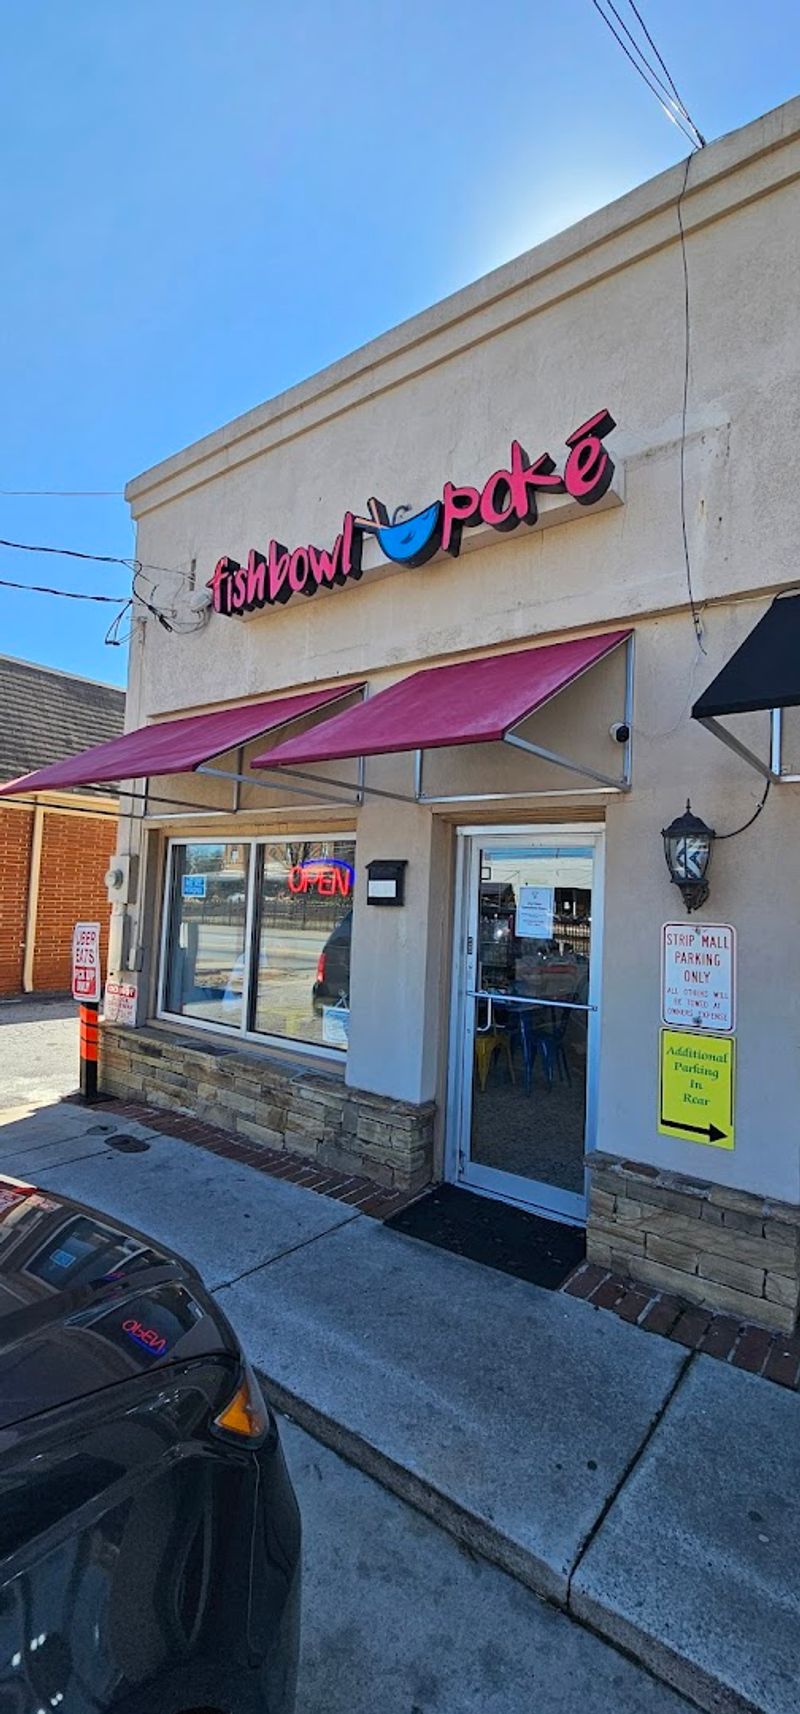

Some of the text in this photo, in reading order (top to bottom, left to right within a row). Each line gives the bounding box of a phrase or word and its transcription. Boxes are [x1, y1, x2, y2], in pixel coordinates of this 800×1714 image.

[207, 510, 360, 614] fishbowl
[287, 864, 352, 897] OPEN
[76, 930, 96, 946] UBER
[666, 933, 729, 949] STRIP MALL
[76, 947, 96, 964] EATS
[674, 950, 721, 967] PARKING
[683, 969, 711, 984] ONLY
[666, 987, 678, 995] ALL
[713, 991, 729, 1000] WILL
[687, 999, 709, 1008] TOWED
[665, 1046, 729, 1064] Additional
[674, 1061, 720, 1081] Parking
[689, 1079, 704, 1090] In
[682, 1093, 712, 1106] Rear
